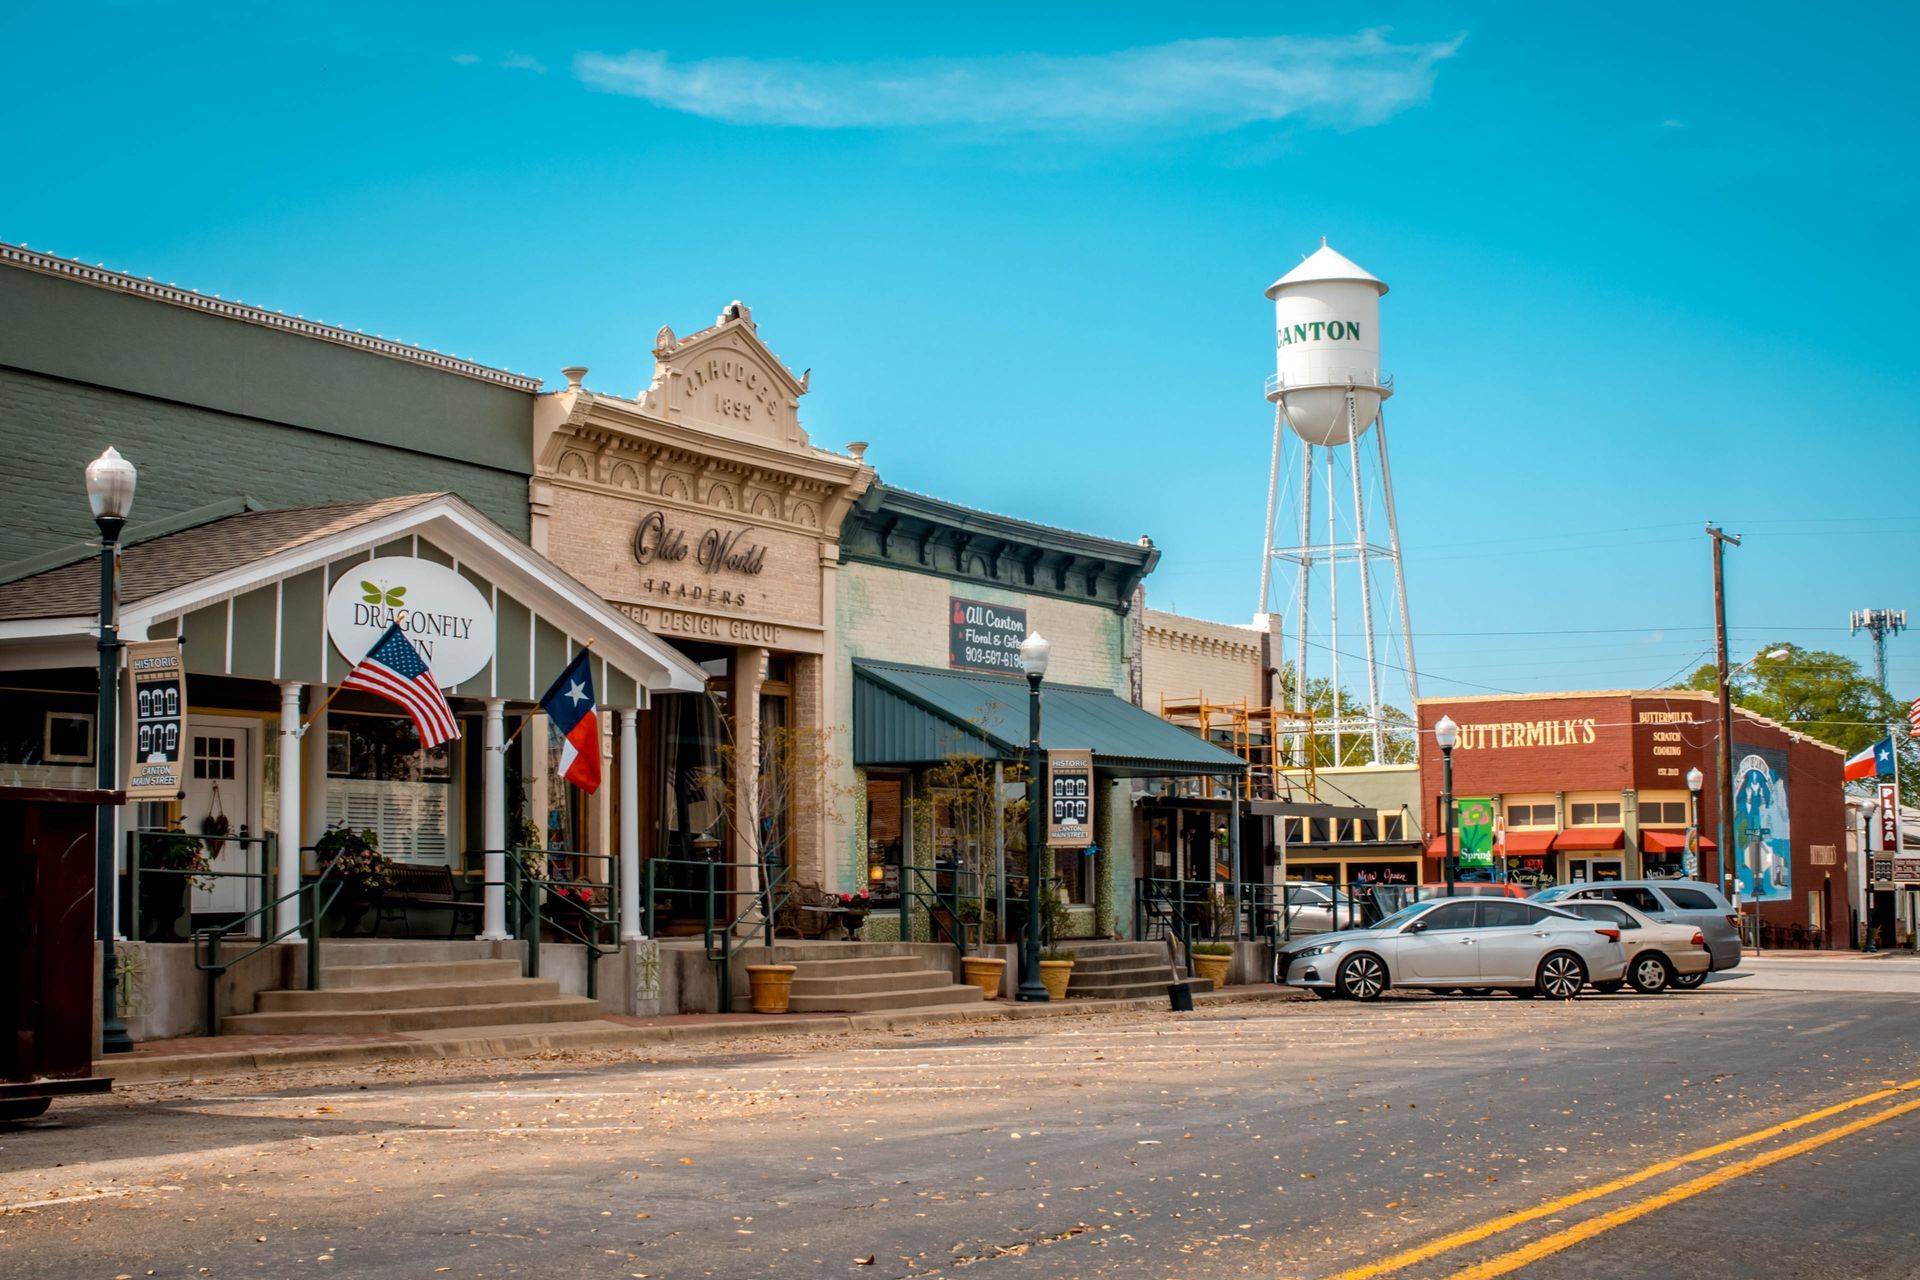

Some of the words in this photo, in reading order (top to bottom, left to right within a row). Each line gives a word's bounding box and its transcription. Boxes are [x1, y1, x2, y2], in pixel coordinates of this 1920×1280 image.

[1277, 320, 1360, 349] CANTON
[714, 393, 752, 422] 1893
[633, 510, 689, 566] Olde
[697, 526, 768, 576] World
[645, 578, 746, 607] TRADERS
[353, 603, 472, 639] DRAGONFLY
[660, 611, 720, 636] DESIGN
[730, 621, 783, 643] GROUP
[985, 610, 1024, 632] Canton
[965, 628, 992, 645] Floral
[993, 634, 1001, 646] &
[134, 656, 178, 669] HISTORIC
[1639, 711, 1693, 724] BUTTERMILK'S
[1653, 732, 1681, 741] SCRATCH
[1653, 746, 1681, 756] COOKING
[132, 776, 150, 786] MAIN
[150, 775, 178, 785] STREET
[141, 766, 172, 776] CANTON
[1882, 788, 1896, 841] PLAZA
[1460, 848, 1491, 862] Spring
